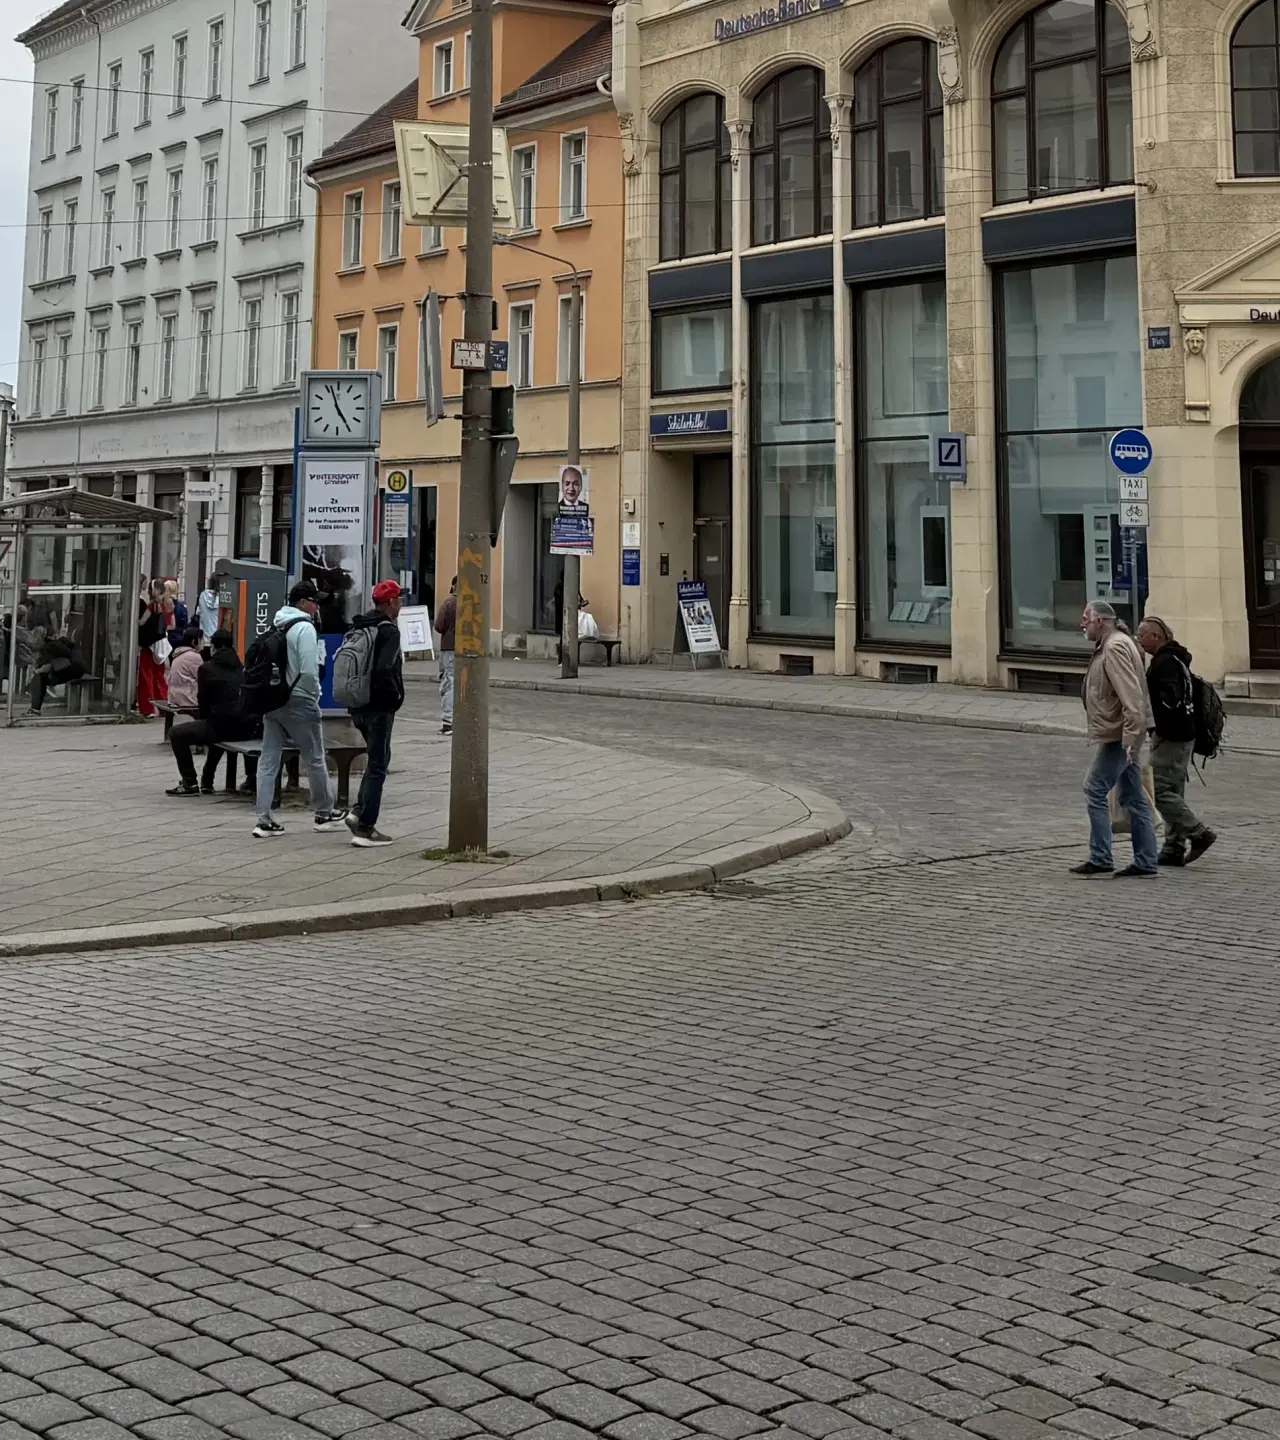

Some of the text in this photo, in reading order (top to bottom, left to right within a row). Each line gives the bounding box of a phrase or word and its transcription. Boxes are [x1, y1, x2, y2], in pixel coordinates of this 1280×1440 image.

[715, 4, 776, 41] Deutsche
[1123, 479, 1143, 489] TAXI
[480, 573, 489, 585] 12
